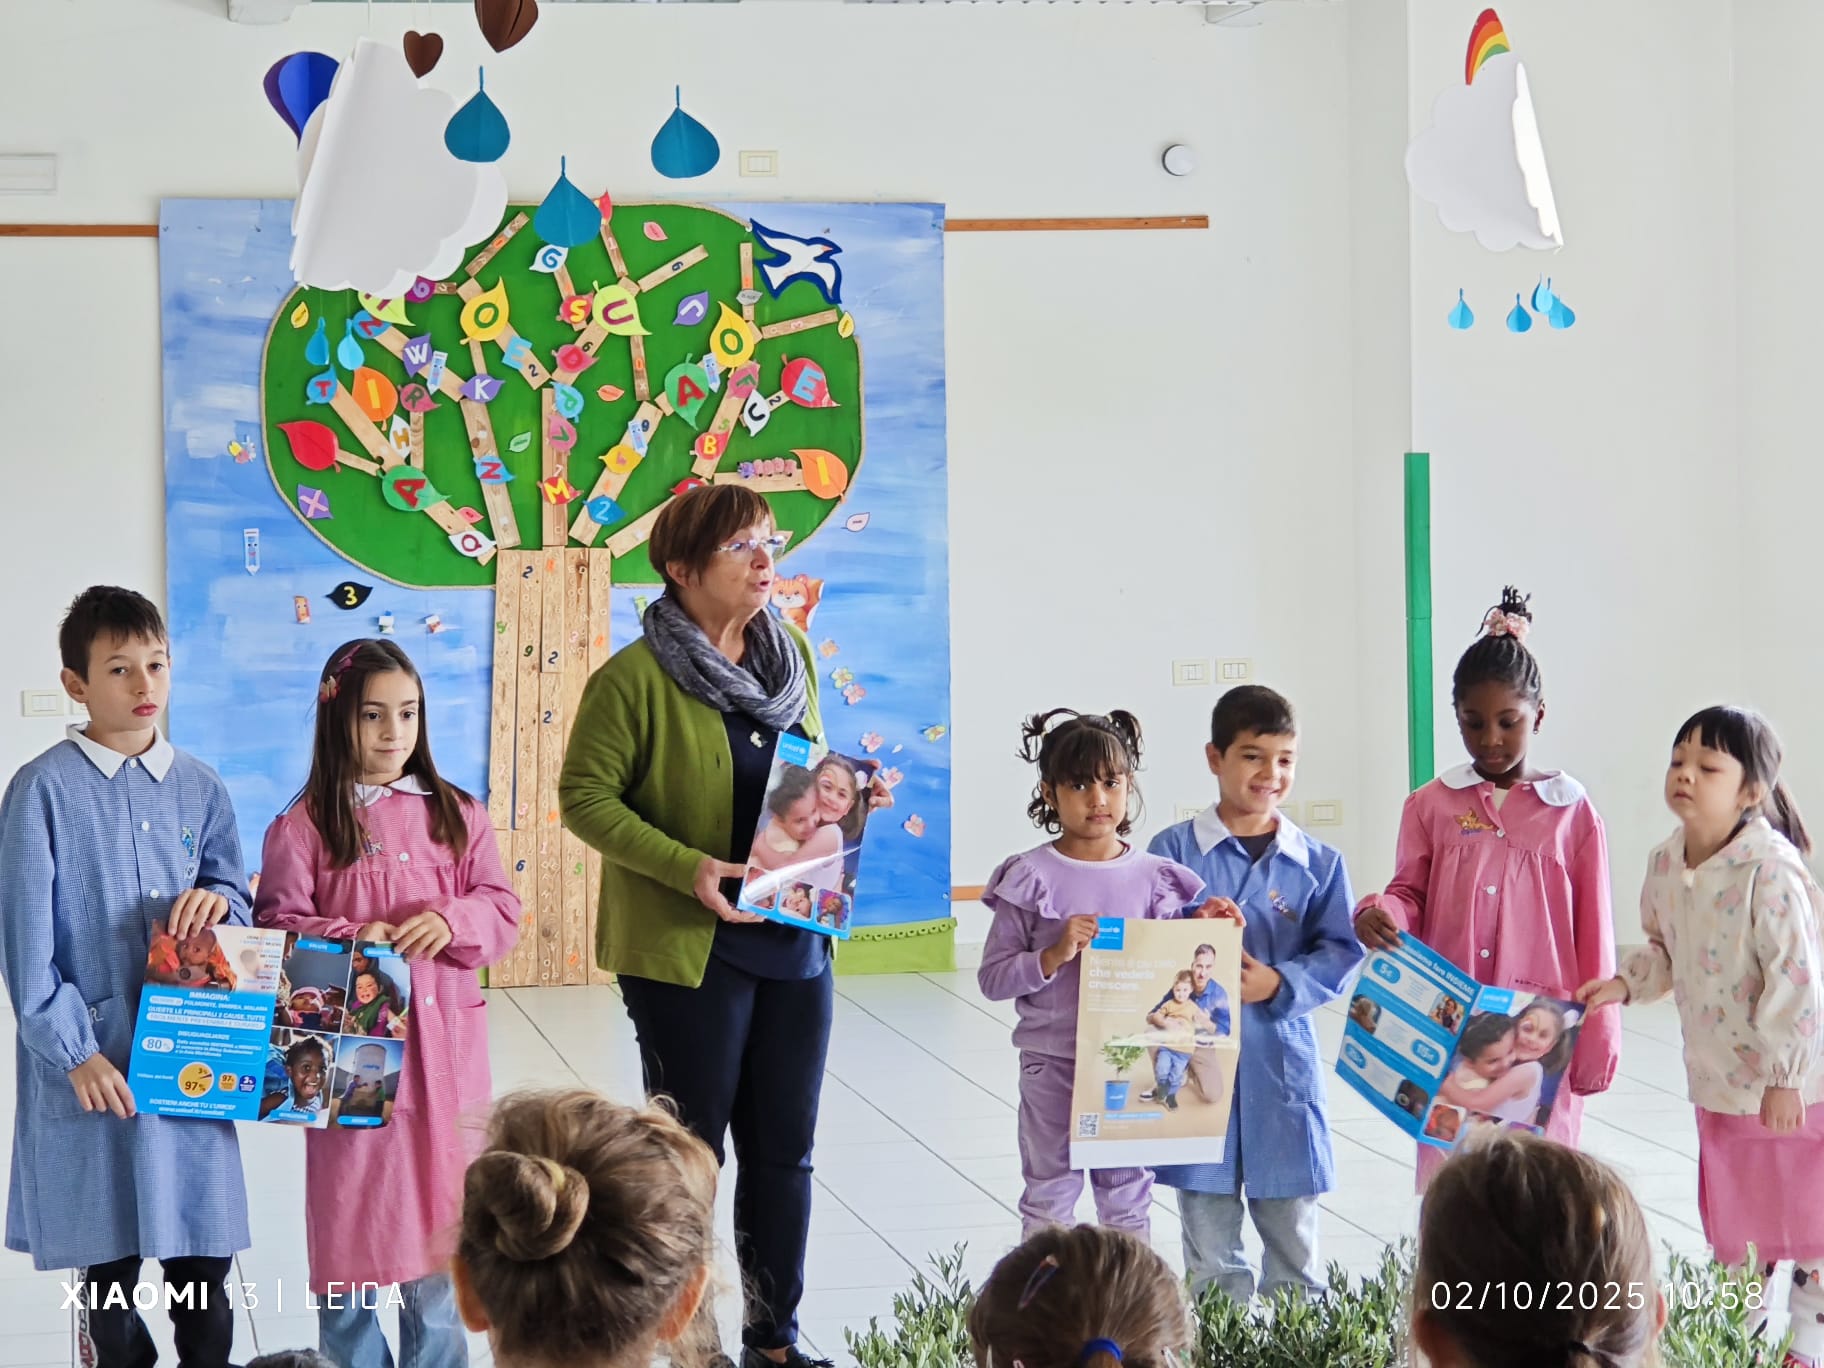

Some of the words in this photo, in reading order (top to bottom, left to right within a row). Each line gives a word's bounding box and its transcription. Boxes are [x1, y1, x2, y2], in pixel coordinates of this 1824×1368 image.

[474, 302, 500, 329] O
[570, 299, 588, 324] S
[602, 299, 635, 325] U
[720, 328, 744, 354] O
[404, 343, 429, 365] W
[315, 381, 332, 397] T
[475, 379, 490, 400] K
[678, 376, 706, 407] A
[792, 366, 823, 402] E
[405, 386, 424, 408] R
[748, 402, 766, 421] C
[393, 430, 410, 446] H
[703, 435, 717, 455] B
[393, 478, 426, 508] A
[544, 477, 570, 504] M
[300, 490, 329, 518] X
[595, 500, 611, 521] 2
[522, 566, 533, 579] 2
[343, 586, 358, 605] 3
[543, 711, 552, 724] 2
[515, 859, 526, 872] 6
